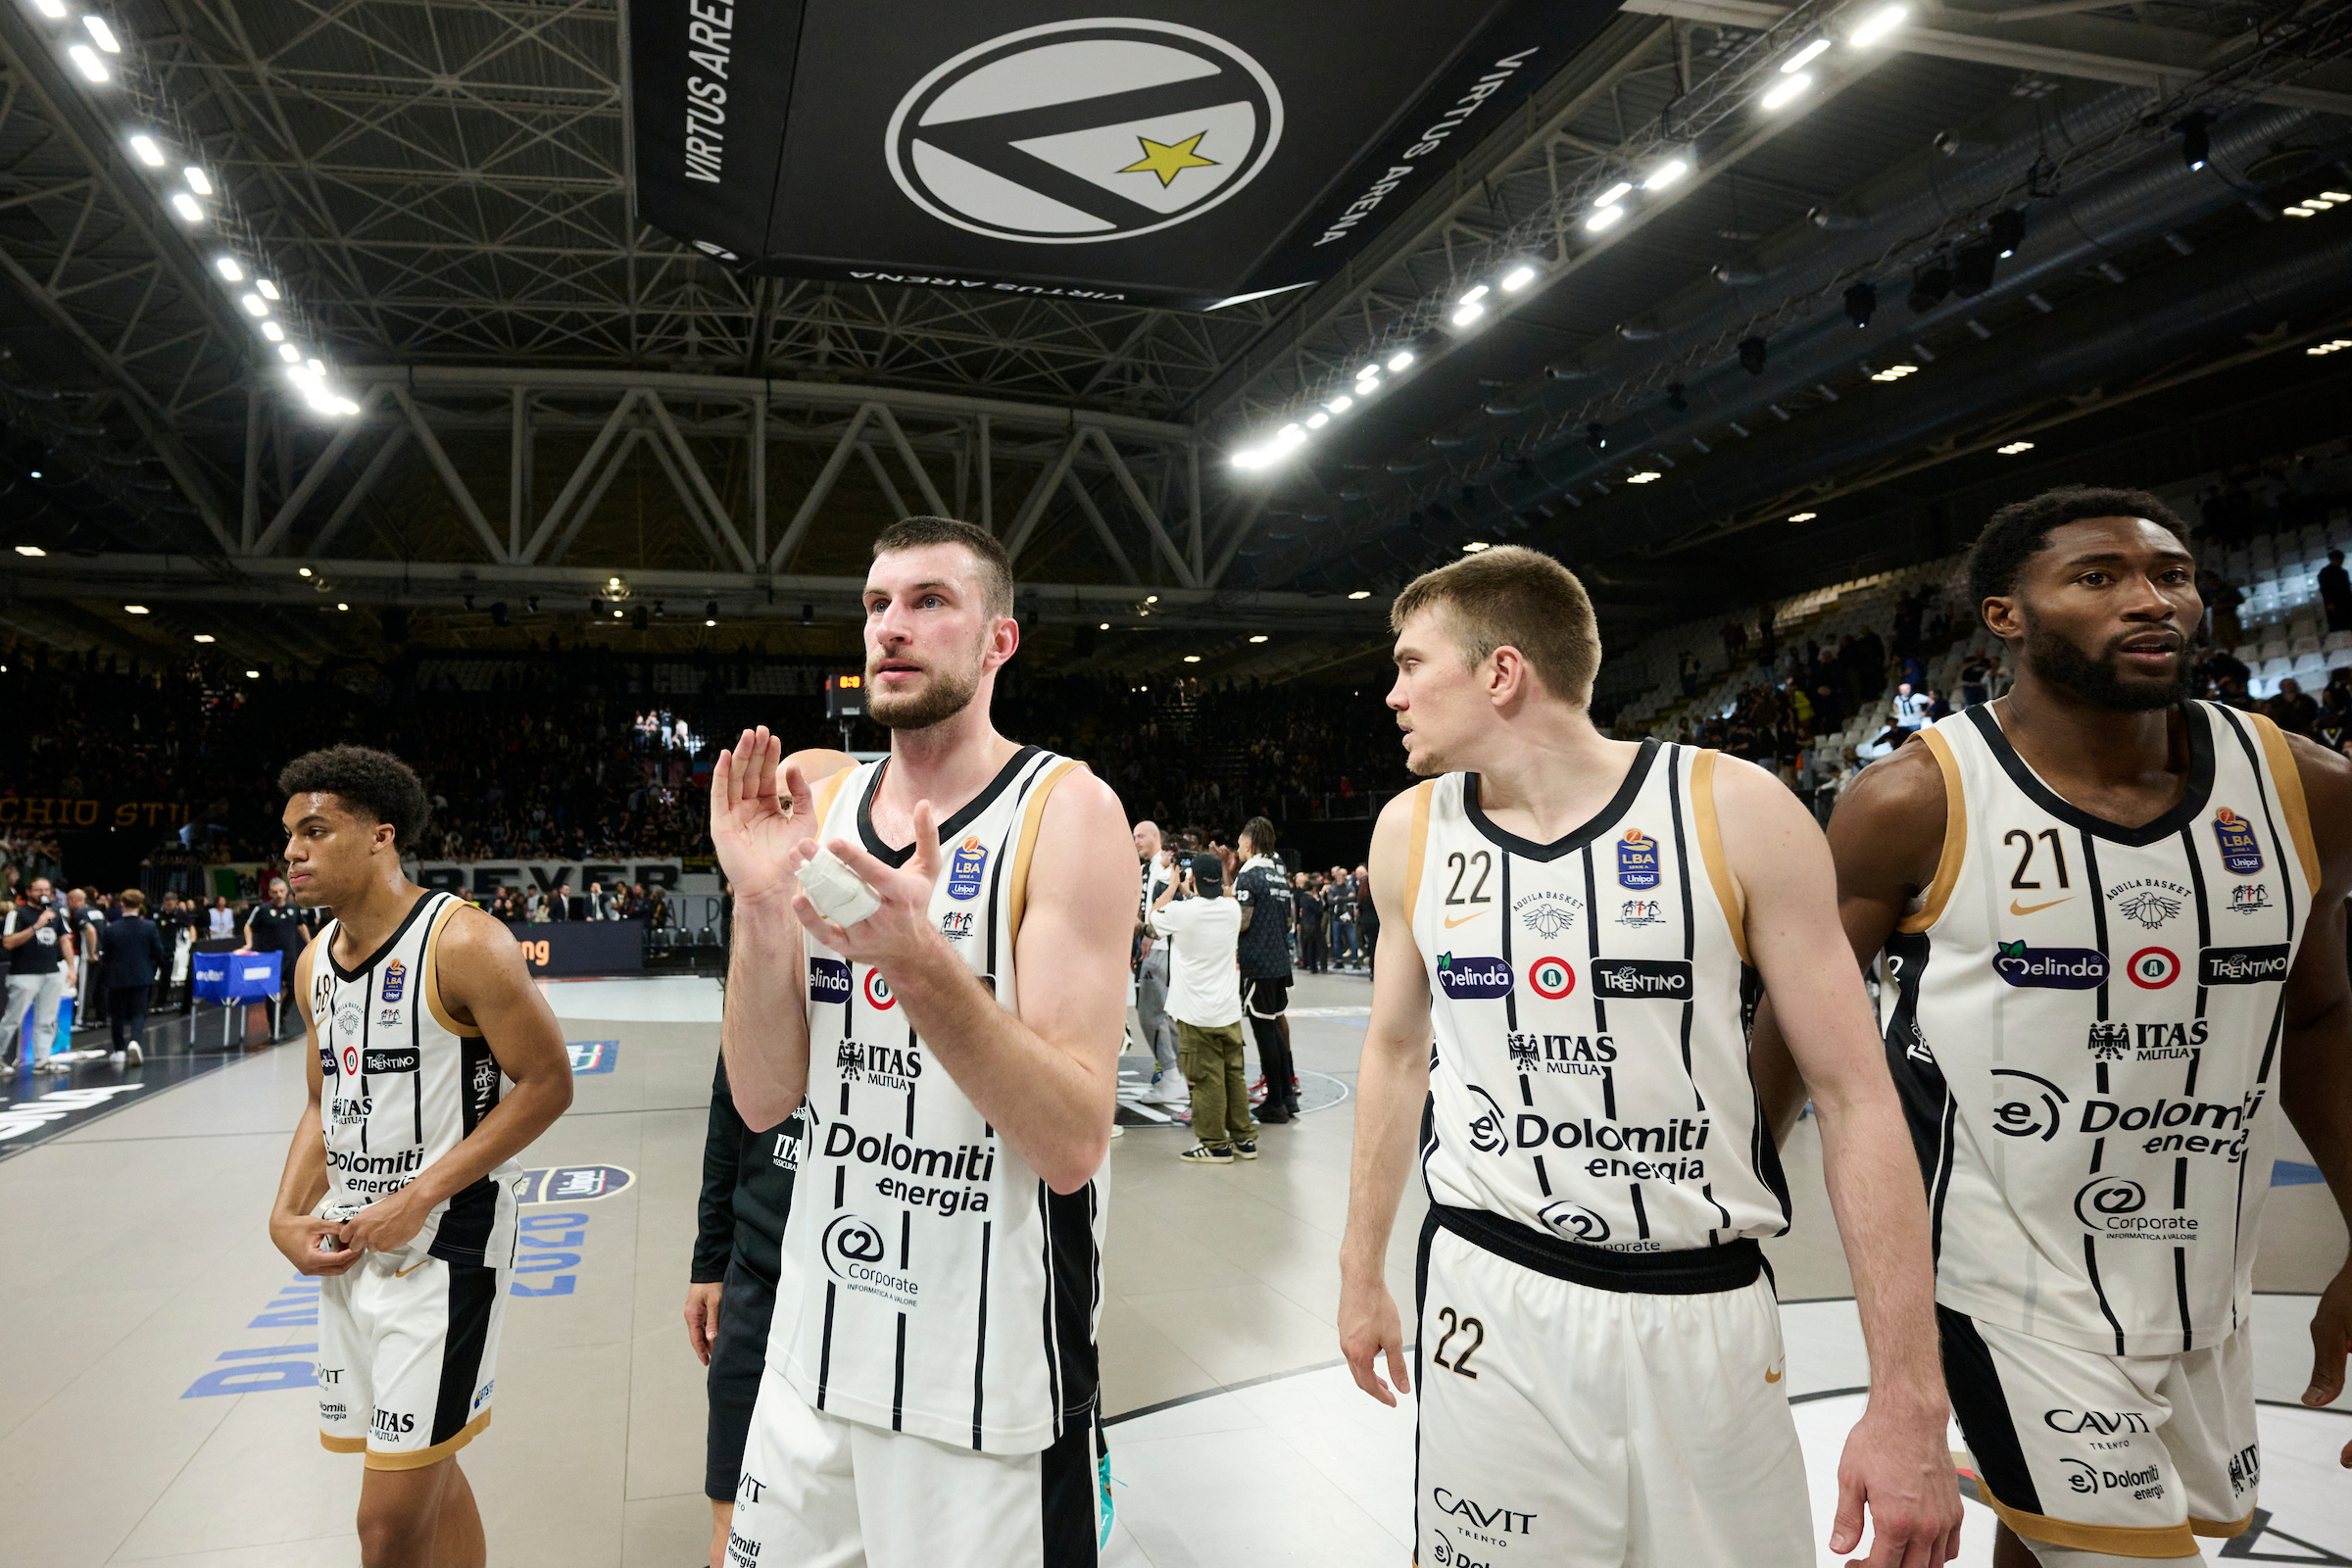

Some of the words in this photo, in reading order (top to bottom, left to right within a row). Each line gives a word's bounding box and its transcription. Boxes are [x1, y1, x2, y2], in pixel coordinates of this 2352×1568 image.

[689, 0, 734, 80] ARE
[1402, 46, 1540, 160] VIRTUS
[685, 75, 727, 183] VIRTUS
[1313, 166, 1414, 247] ARENA
[850, 270, 986, 287] ARENA
[993, 282, 1125, 301] VIRTUS
[2223, 834, 2254, 847] LBA
[956, 862, 980, 873] LBA
[1622, 854, 1655, 864] LBA
[2003, 828, 2071, 891] 21
[2232, 857, 2258, 868] Unipol
[955, 884, 976, 895] Unipol
[1445, 850, 1492, 906] 22
[1627, 874, 1654, 885] Unipol
[2106, 880, 2142, 901] AQUILA
[2145, 878, 2192, 899] BASKET
[1513, 893, 1544, 912] AQUILA
[1546, 891, 1585, 910] BASKET
[1440, 966, 1509, 988] Melinda
[1999, 956, 2103, 977] Melinda
[2210, 956, 2286, 979] TRENTINO
[386, 976, 402, 985] LBA
[810, 966, 849, 992] elinda
[1600, 969, 1686, 993] TRENTINO
[315, 973, 331, 1014] 68
[2136, 1020, 2209, 1049] ITAS
[1543, 1035, 1618, 1062] ITAS
[2136, 1049, 2190, 1061] MUTUA
[367, 1055, 415, 1071] TRENTINO
[867, 1045, 922, 1079] ITAS
[1545, 1062, 1601, 1076] MUTUA
[867, 1073, 907, 1091] MUTUA
[1517, 1113, 1710, 1152] Dolomiti
[772, 1133, 803, 1163] ITA
[823, 1121, 995, 1182] Dolomiti
[1584, 1156, 1704, 1185] energia
[875, 1177, 989, 1216] energia
[2106, 1215, 2199, 1232] Corporate
[849, 1263, 918, 1295] Corporate
[847, 1283, 889, 1299] INFORMATICA
[893, 1295, 917, 1307] VALORE
[1433, 1306, 1484, 1380] 22
[376, 1408, 415, 1433] ITAS
[2044, 1409, 2150, 1436] CAVIT
[2089, 1440, 2131, 1450] TRENTO
[2102, 1464, 2160, 1489] Dolomiti
[2133, 1484, 2165, 1500] energia
[1434, 1487, 1538, 1535] CAVIT
[1457, 1527, 1507, 1547] TRENTO
